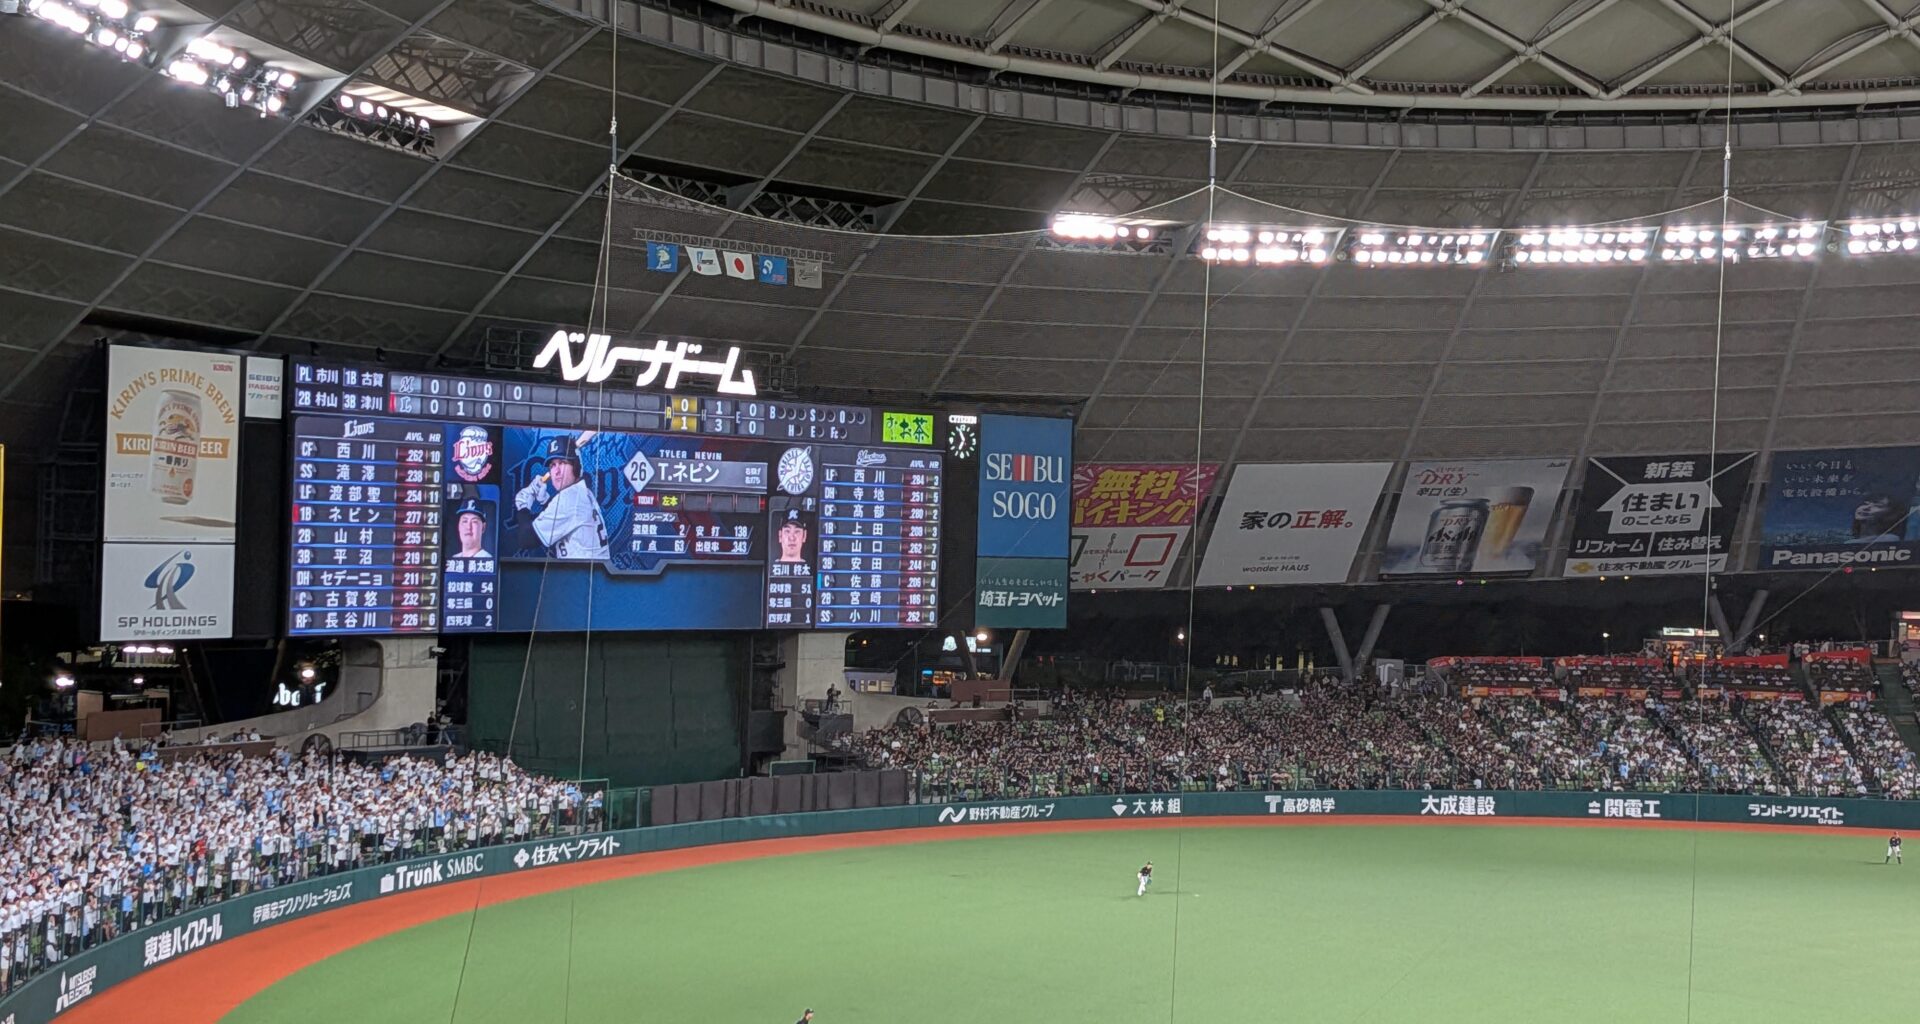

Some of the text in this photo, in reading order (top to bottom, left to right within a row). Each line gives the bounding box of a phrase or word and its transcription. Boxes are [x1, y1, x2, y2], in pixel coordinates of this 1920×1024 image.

[532, 330, 757, 396] ベルーナドーム
[300, 367, 384, 387] PL 市川 1B 古賀
[110, 371, 157, 420] KIRIN'S
[160, 368, 205, 389] PRIME
[205, 382, 236, 424] BREW
[299, 391, 382, 410] 2B 村山 3B 津川
[431, 380, 439, 394] 0
[457, 381, 466, 396] 0
[484, 384, 492, 398] 0
[513, 386, 522, 400] 0
[681, 399, 688, 412] 0
[716, 401, 723, 415] 1
[750, 403, 757, 417] 0
[430, 399, 439, 414] 0
[456, 401, 465, 415] 1
[483, 403, 491, 418] 0
[681, 416, 688, 430] 1
[715, 419, 722, 432] 3
[749, 421, 756, 434] 0
[343, 420, 374, 437] Lions
[405, 432, 441, 442] AVG. HR
[337, 443, 375, 460] 西川
[431, 451, 440, 462] 10
[452, 440, 493, 462] Lions
[660, 450, 722, 460] TYLER NEVIN
[631, 462, 719, 483] 26 T.ネビン
[986, 453, 1063, 482] SEIBU
[1644, 461, 1696, 479] 新築
[434, 471, 439, 482] 0
[854, 469, 885, 483] 西川
[1090, 469, 1179, 499] 無料
[1420, 472, 1468, 485] DRY
[330, 485, 380, 502] 渡部聖
[430, 491, 438, 502] 11
[451, 484, 458, 498] P
[853, 487, 884, 501] 寺地
[993, 491, 1056, 519] SOGO
[1621, 492, 1700, 513] 住まい
[329, 507, 380, 522] ネビン
[428, 512, 437, 523] 21
[1240, 510, 1353, 530] 家の正解。
[1621, 513, 1692, 526] のことなら
[334, 528, 373, 544] 山村
[432, 531, 437, 543] 4
[852, 522, 883, 535] 上田
[851, 540, 883, 553] 山口
[1575, 535, 1722, 553] リフォーム 住み替え
[334, 549, 372, 564] 平沼
[431, 552, 437, 564] 0
[851, 557, 882, 570] 安田
[1772, 546, 1911, 566] Panasonic
[773, 565, 790, 576] 石川
[1242, 564, 1310, 573] wonder HAUS
[1597, 558, 1721, 572] 住友不動産グループ
[320, 570, 382, 585] セデーニョ
[430, 573, 436, 585] 7
[481, 582, 493, 593] 54
[801, 584, 812, 594] 51
[326, 591, 377, 607] 古賀悠
[429, 593, 436, 605] 7
[486, 598, 493, 609] 0
[979, 590, 1063, 607] 埼玉トヨペット
[118, 616, 217, 628] SP HOLDINGS
[325, 612, 376, 628] 長谷川
[429, 614, 435, 626] 6
[485, 615, 492, 626] 2
[849, 609, 880, 623] 小川
[969, 803, 1055, 821] 野村不動産グループ
[1133, 798, 1181, 814] 大林組
[1283, 797, 1335, 813] 高砂熱学
[1421, 794, 1496, 815] 大成建設
[1604, 798, 1661, 818] 関電工
[1818, 817, 1844, 825] Group
[531, 835, 620, 867] 住友ベークライト
[396, 853, 484, 890] Trunk SMBC
[253, 881, 352, 925] 伊藤忠テクノソリューションズ
[144, 913, 223, 967] 東進ハイスクール
